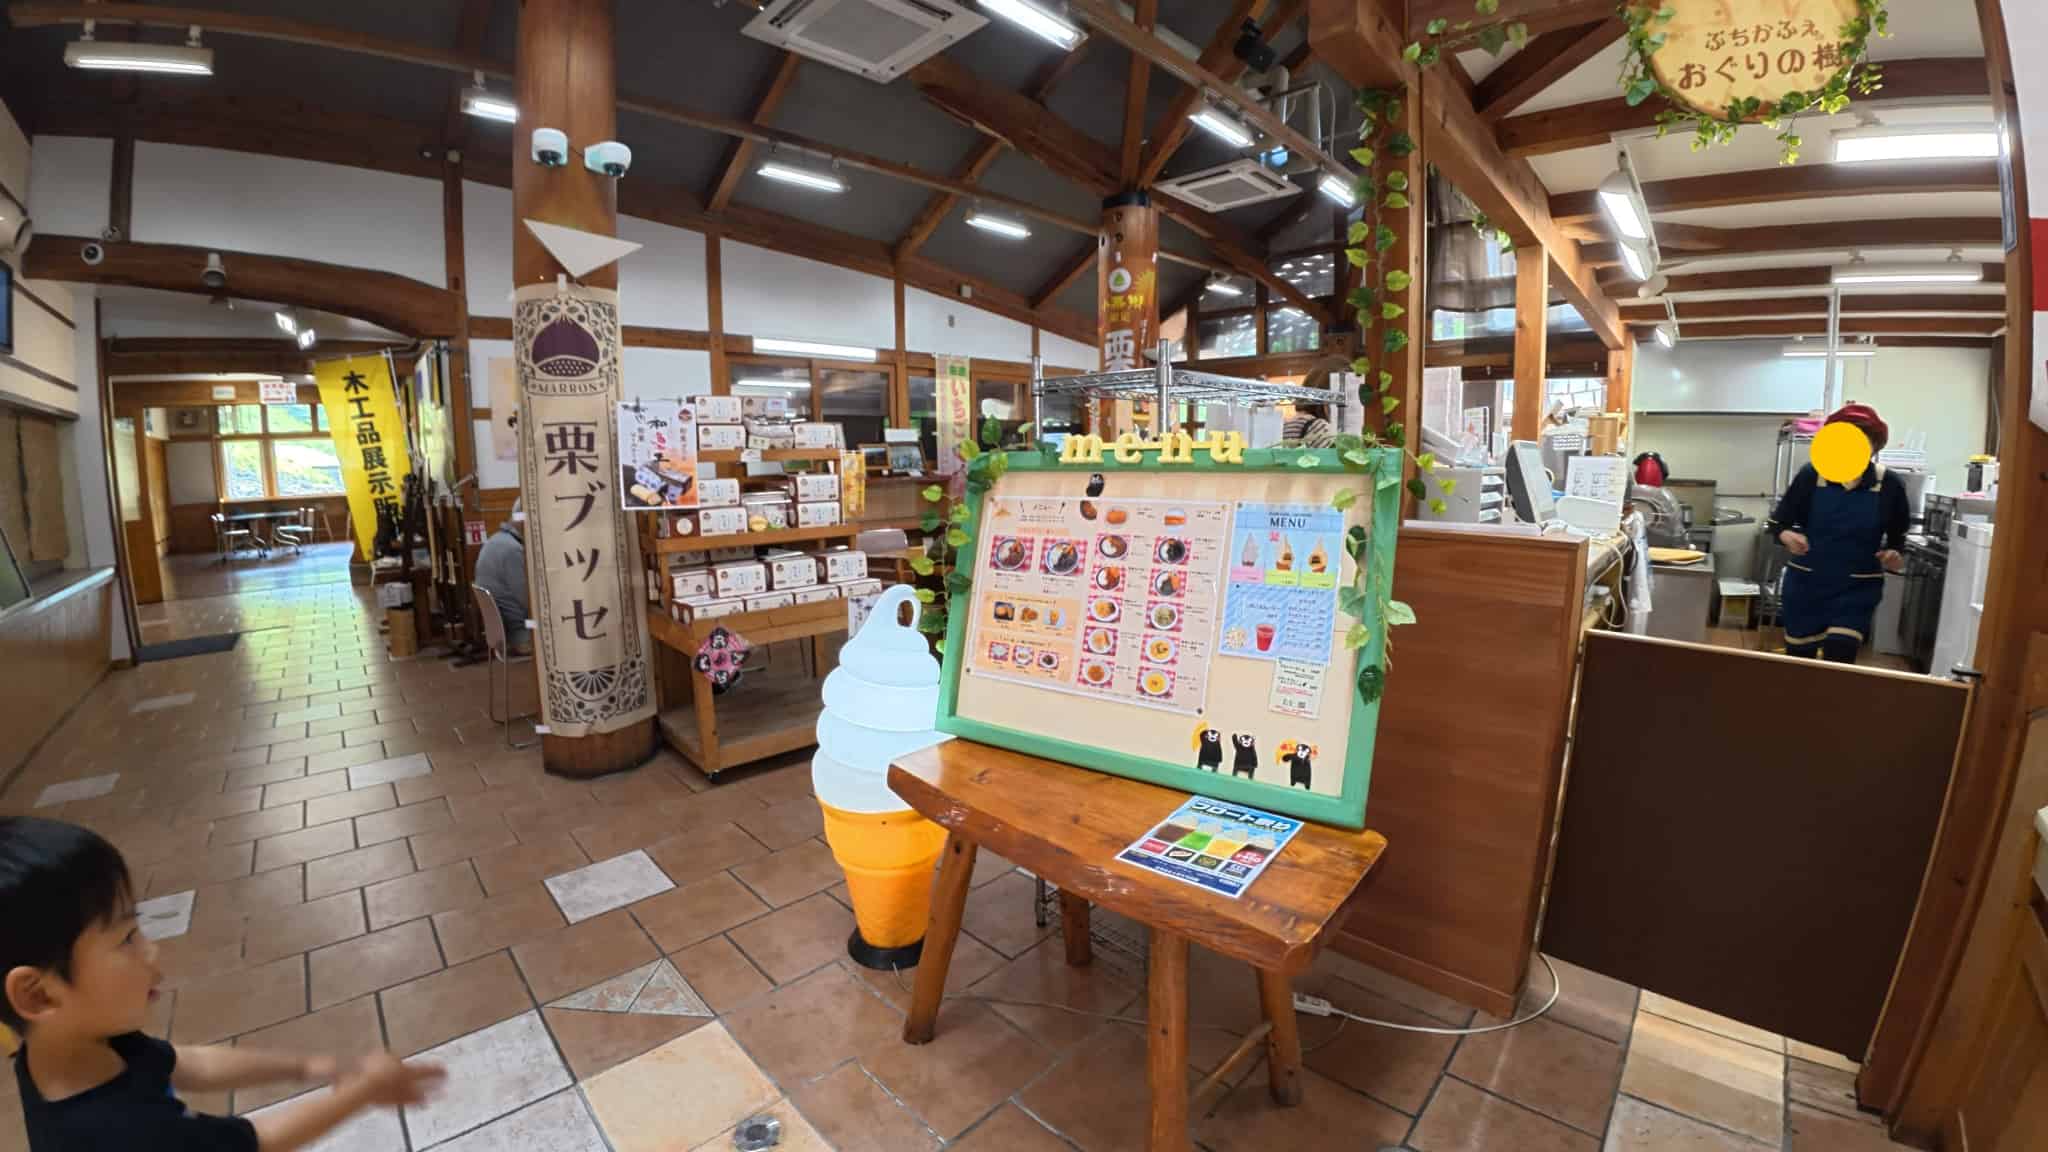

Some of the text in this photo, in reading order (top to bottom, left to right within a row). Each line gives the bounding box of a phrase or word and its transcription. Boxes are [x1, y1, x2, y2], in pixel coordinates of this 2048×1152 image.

[1678, 41, 1842, 90] おぐりの樹
[539, 383, 598, 393] MARRON
[1058, 431, 1245, 464] menu
[1270, 517, 1306, 528] MENU
